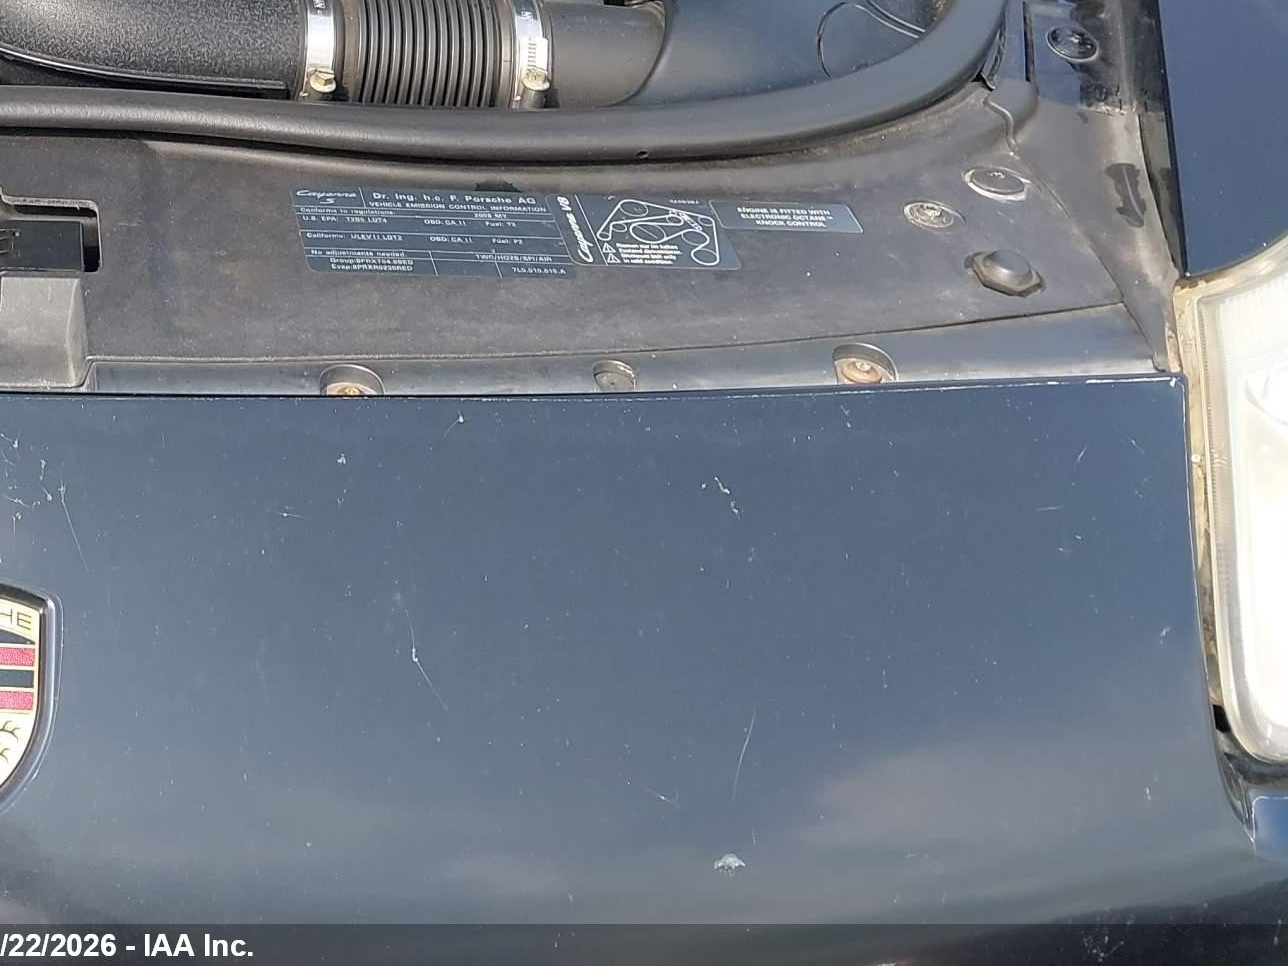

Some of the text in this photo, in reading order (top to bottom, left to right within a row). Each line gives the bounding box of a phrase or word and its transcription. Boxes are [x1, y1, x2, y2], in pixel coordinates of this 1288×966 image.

[296, 190, 357, 199] Cayenne
[395, 193, 417, 201] Ing.
[423, 194, 444, 202] h.c.
[465, 195, 512, 204] Porsche
[557, 196, 572, 211] V8
